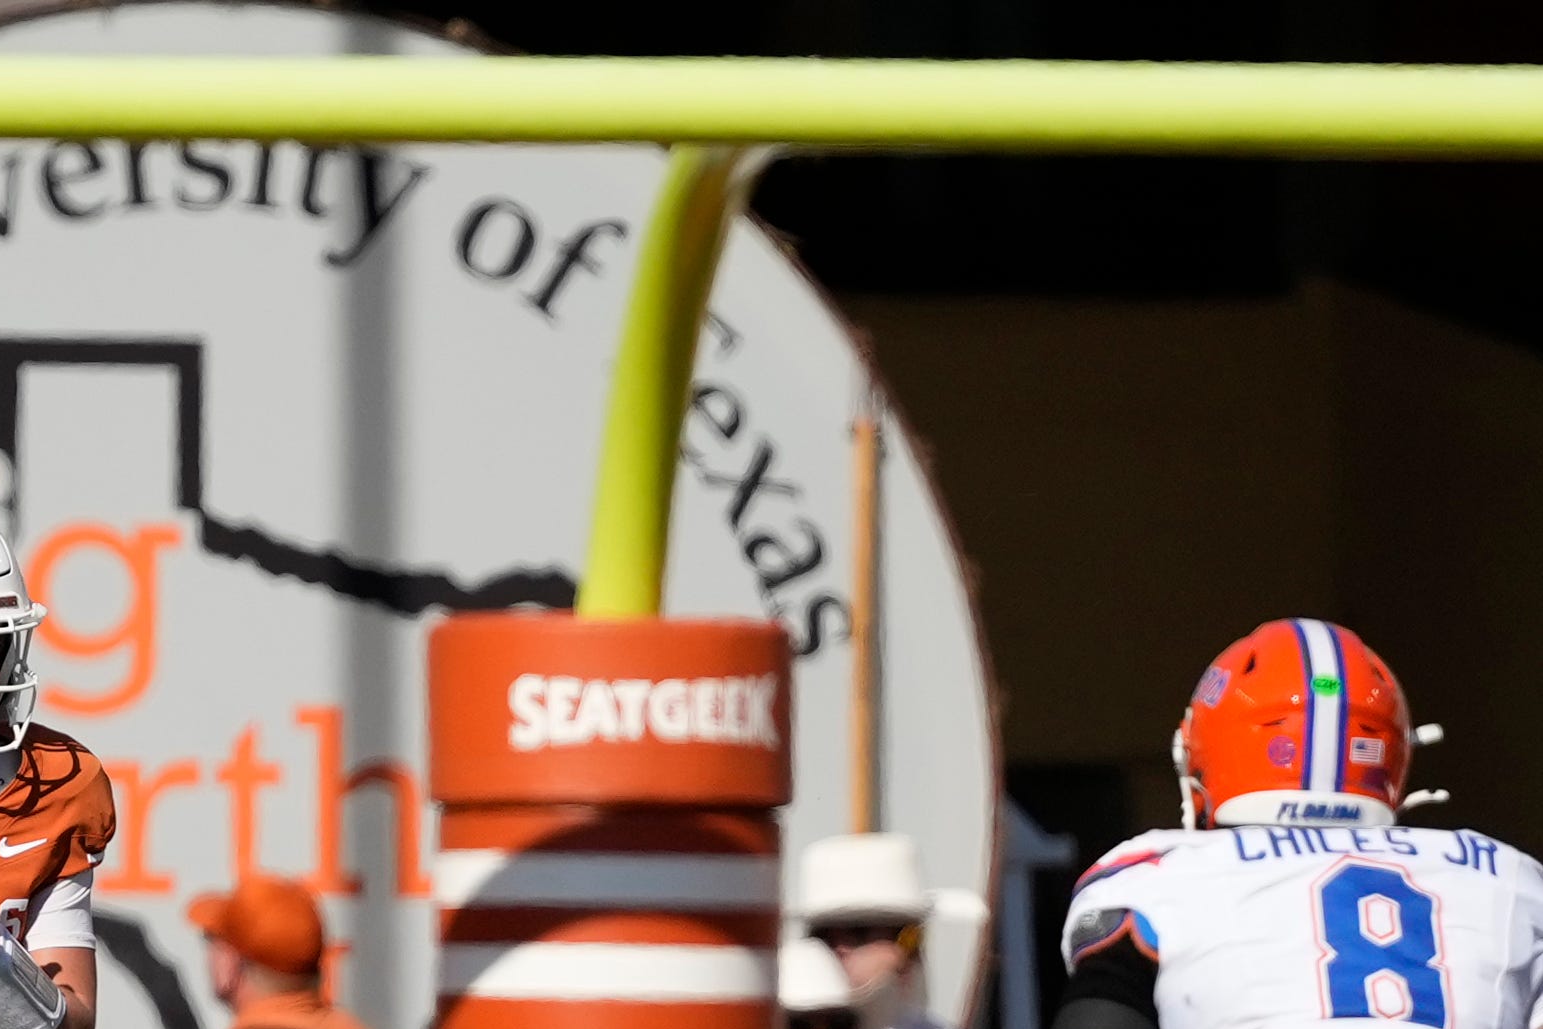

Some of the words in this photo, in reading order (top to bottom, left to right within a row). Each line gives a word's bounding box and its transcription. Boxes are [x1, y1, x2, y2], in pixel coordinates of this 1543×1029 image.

[454, 197, 629, 322] of
[507, 672, 781, 751] SEATGEEK
[1232, 828, 1419, 862] CHILES
[1443, 831, 1499, 876] JR
